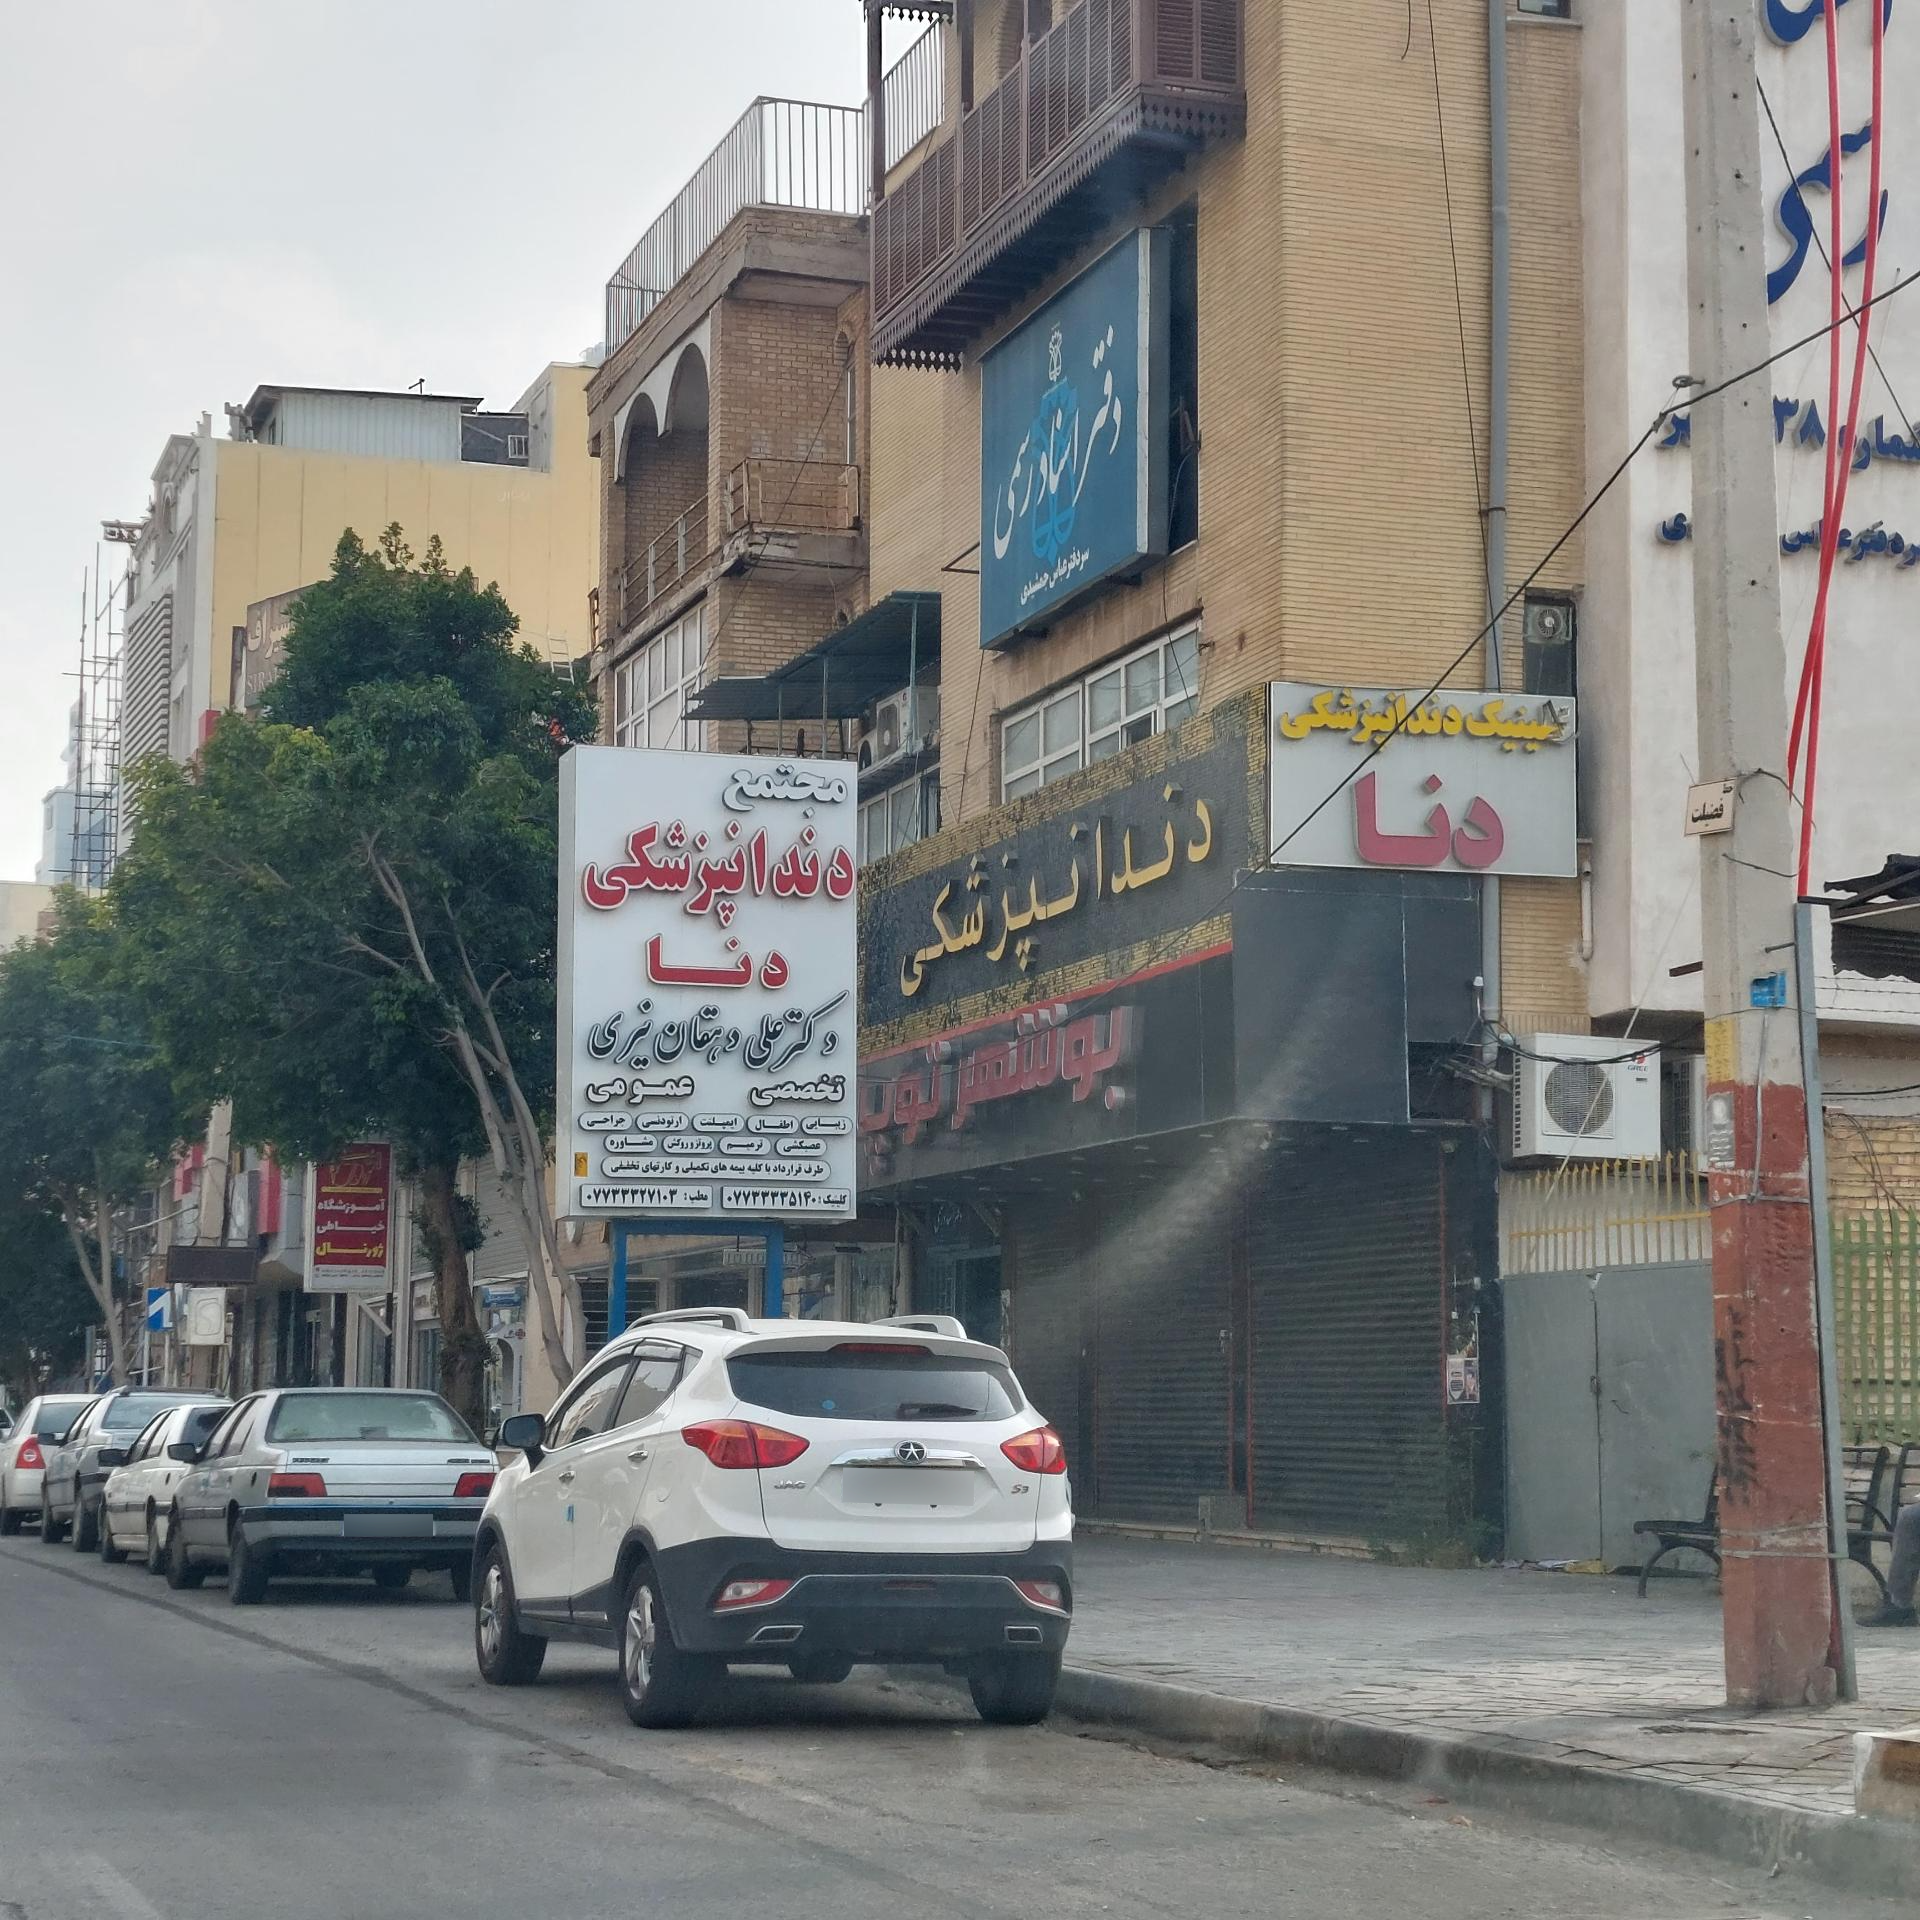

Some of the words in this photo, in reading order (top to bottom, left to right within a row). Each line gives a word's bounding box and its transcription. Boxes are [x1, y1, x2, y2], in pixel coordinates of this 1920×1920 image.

[1072, 324, 1122, 507] دفتر
[1036, 406, 1080, 505] اسناد
[993, 427, 1034, 560] رسمی
[1279, 687, 1463, 753] دندانپزشکی
[722, 764, 849, 819] مجتمع
[1354, 771, 1505, 868] دنا
[582, 816, 857, 928] دندانپزشکی
[900, 784, 1213, 996] دندانپزشکی
[646, 933, 791, 990] دنا
[653, 1004, 744, 1064] دهقان
[769, 989, 850, 1073] دکتر
[743, 1012, 787, 1069] علی
[951, 1003, 1130, 1131] بوشهر
[585, 1075, 696, 1106] عمومی
[750, 1073, 846, 1107] تخصصی
[586, 1114, 626, 1127] جراحی
[641, 1115, 682, 1128] ارتودنسی
[699, 1117, 737, 1129] ایمپلنت
[755, 1119, 793, 1131] اطفال
[805, 1117, 846, 1130] زیبایی
[609, 1136, 654, 1149] مشاوره
[726, 1139, 763, 1151] ترمیم
[674, 1165, 680, 1173] و
[729, 1164, 746, 1175] بیمه
[747, 1163, 764, 1175] کلیه
[765, 1163, 771, 1175] با
[772, 1163, 803, 1177] قرارداد
[804, 1163, 824, 1177] طرف
[586, 1187, 678, 1205] ۰۷۷۳۳۳۲۷۱۰۳
[726, 1189, 817, 1207] ۰۷۷۳۳۳۳۵۱۴۰
[317, 1199, 386, 1214] آموزشگاه
[316, 1220, 386, 1234] خیاطی
[315, 1242, 385, 1258] ژورنال
[774, 1480, 806, 1489] JAC
[1011, 1484, 1030, 1494] S3
